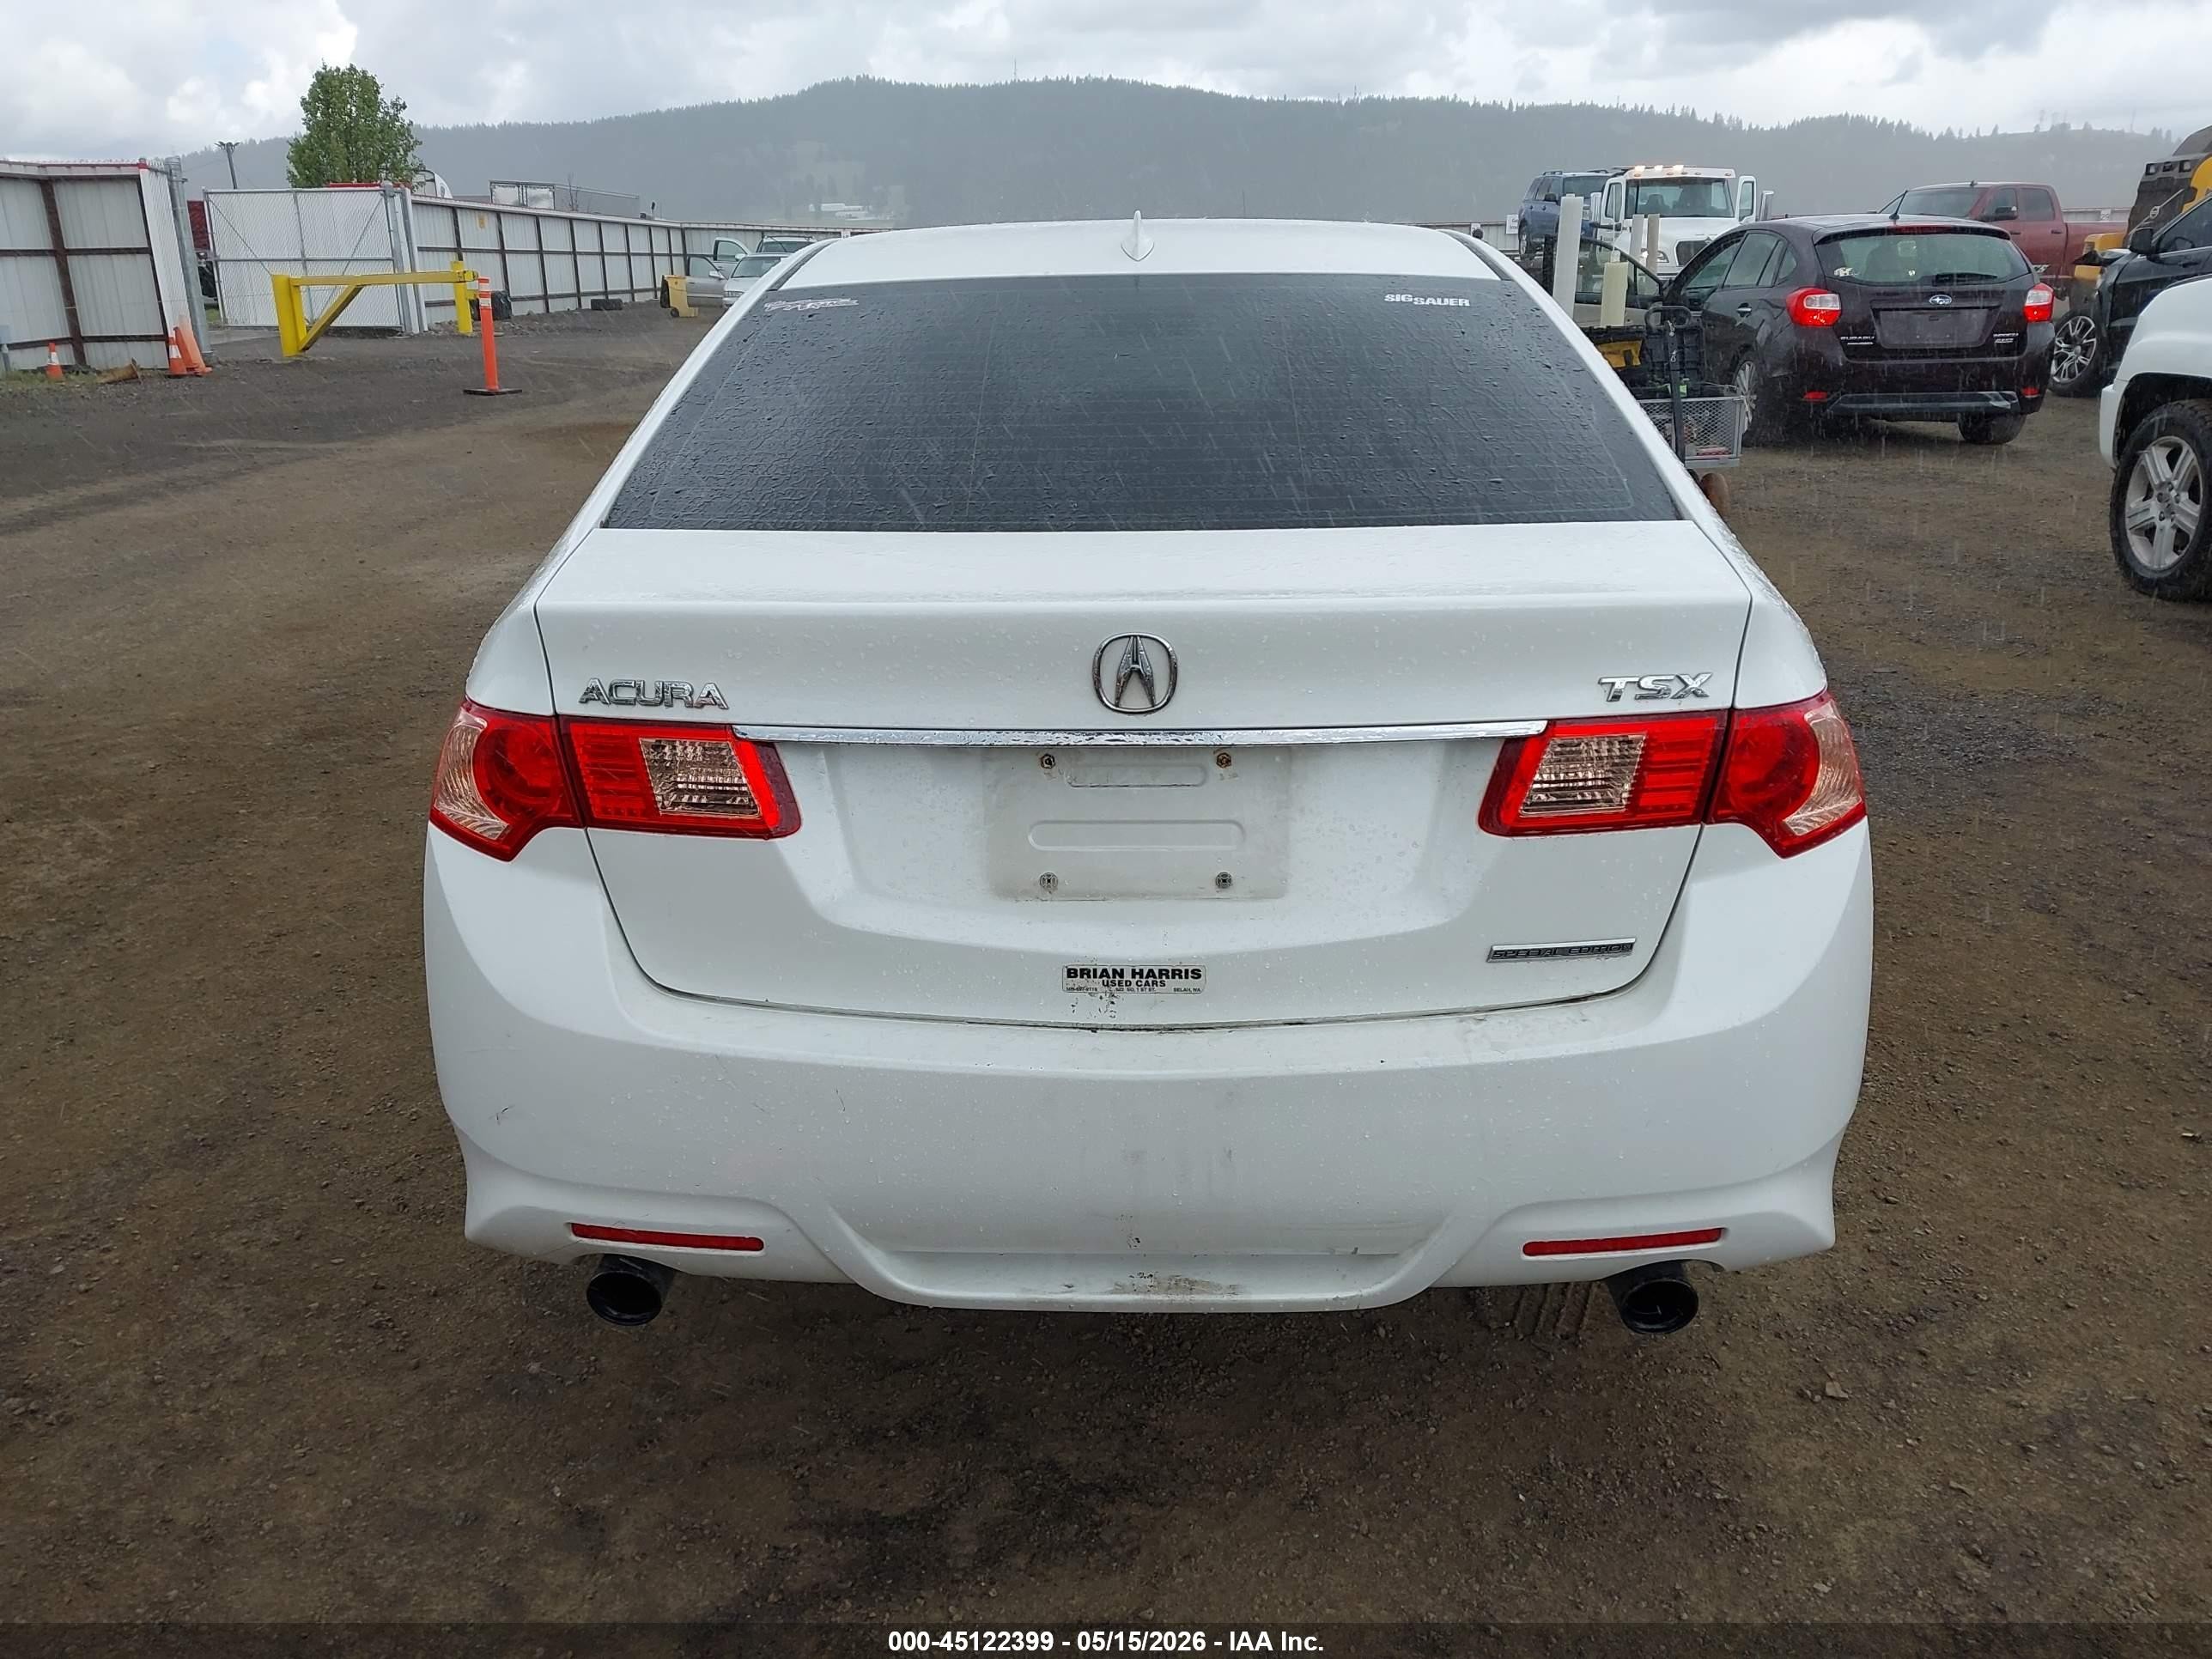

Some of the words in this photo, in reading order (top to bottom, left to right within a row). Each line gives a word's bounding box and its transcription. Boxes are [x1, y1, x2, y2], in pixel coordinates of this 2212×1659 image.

[578, 678, 729, 710] ACURA
[1598, 672, 1713, 702] TSX
[1492, 948, 1560, 959] SPECIAL
[1569, 943, 1634, 954] EDITION
[1066, 968, 1125, 979] BRIAN
[1131, 968, 1202, 980] HARRIS
